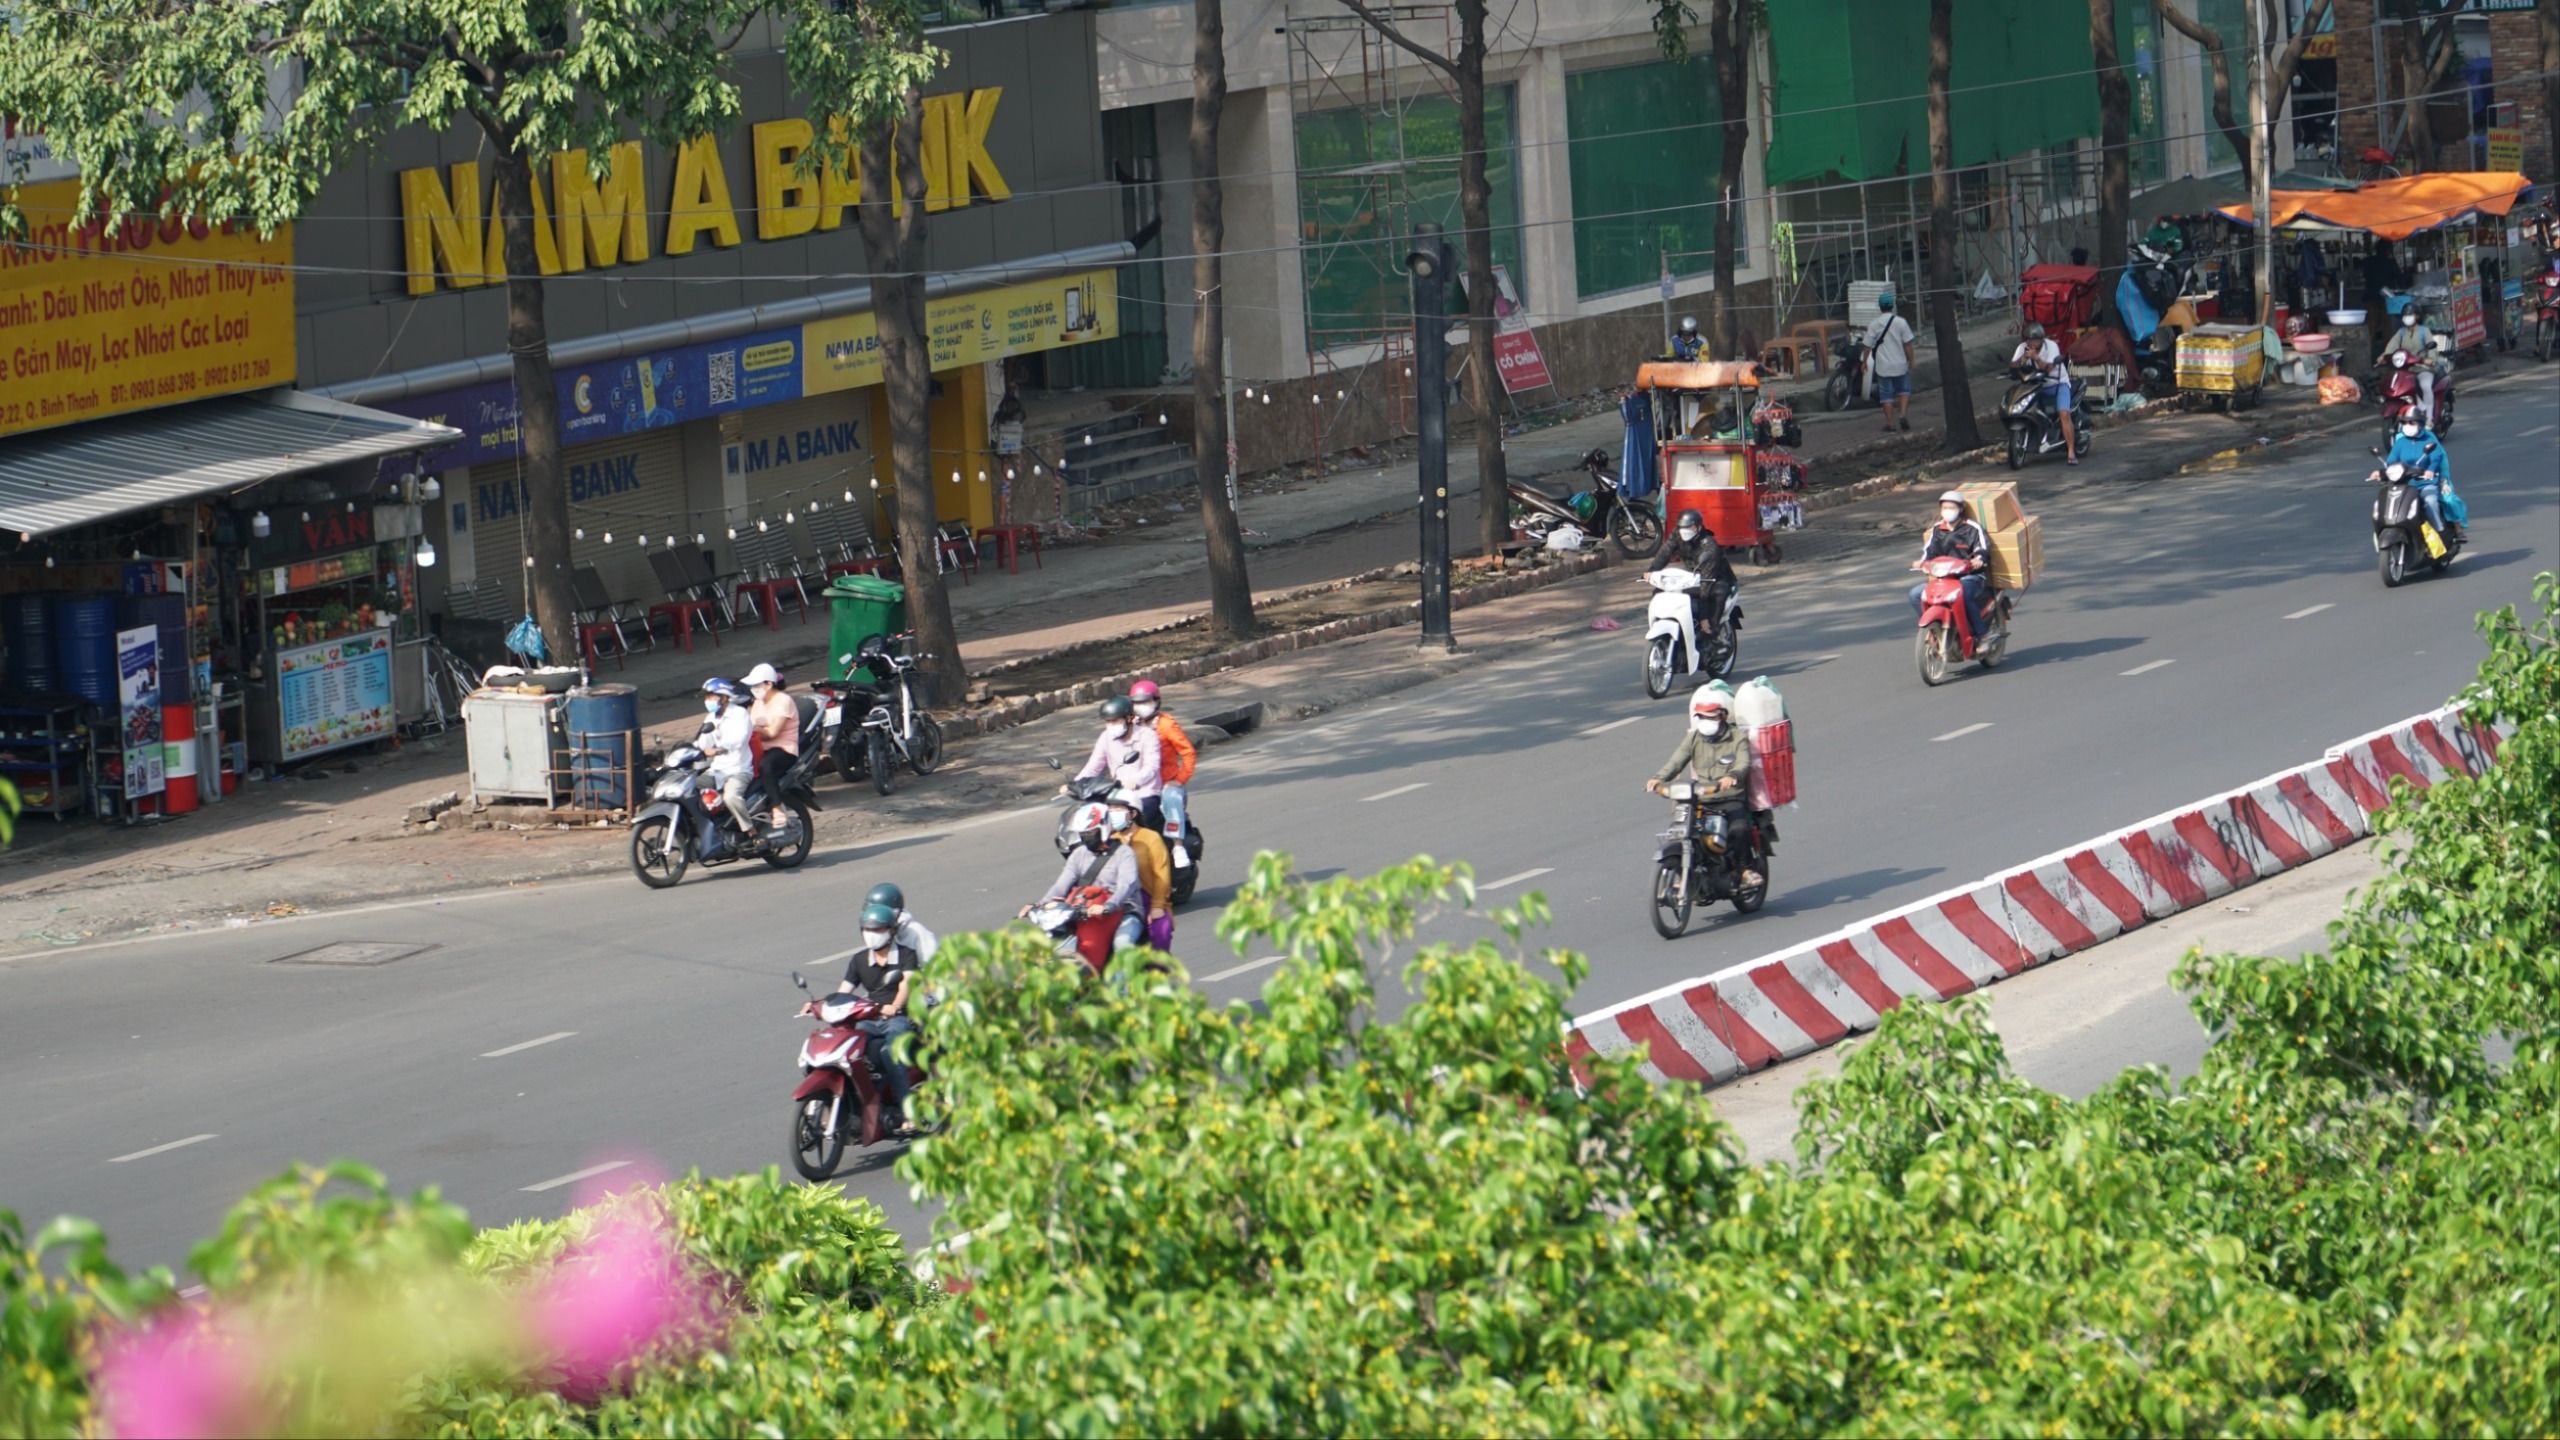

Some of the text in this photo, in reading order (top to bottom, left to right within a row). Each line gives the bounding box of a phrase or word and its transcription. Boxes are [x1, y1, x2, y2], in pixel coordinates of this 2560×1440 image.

[665, 130, 741, 256] A
[102, 333, 129, 368] Lọc
[181, 317, 209, 348] Các
[215, 311, 249, 346] Loại
[826, 335, 880, 359] NAM A BA
[131, 379, 155, 400] 0903
[158, 376, 176, 395] 668
[178, 371, 196, 390] 398
[205, 366, 229, 387] 0902
[231, 362, 249, 382] 612
[775, 435, 791, 467] A
[796, 420, 861, 462] BANK
[570, 453, 640, 503] BANK
